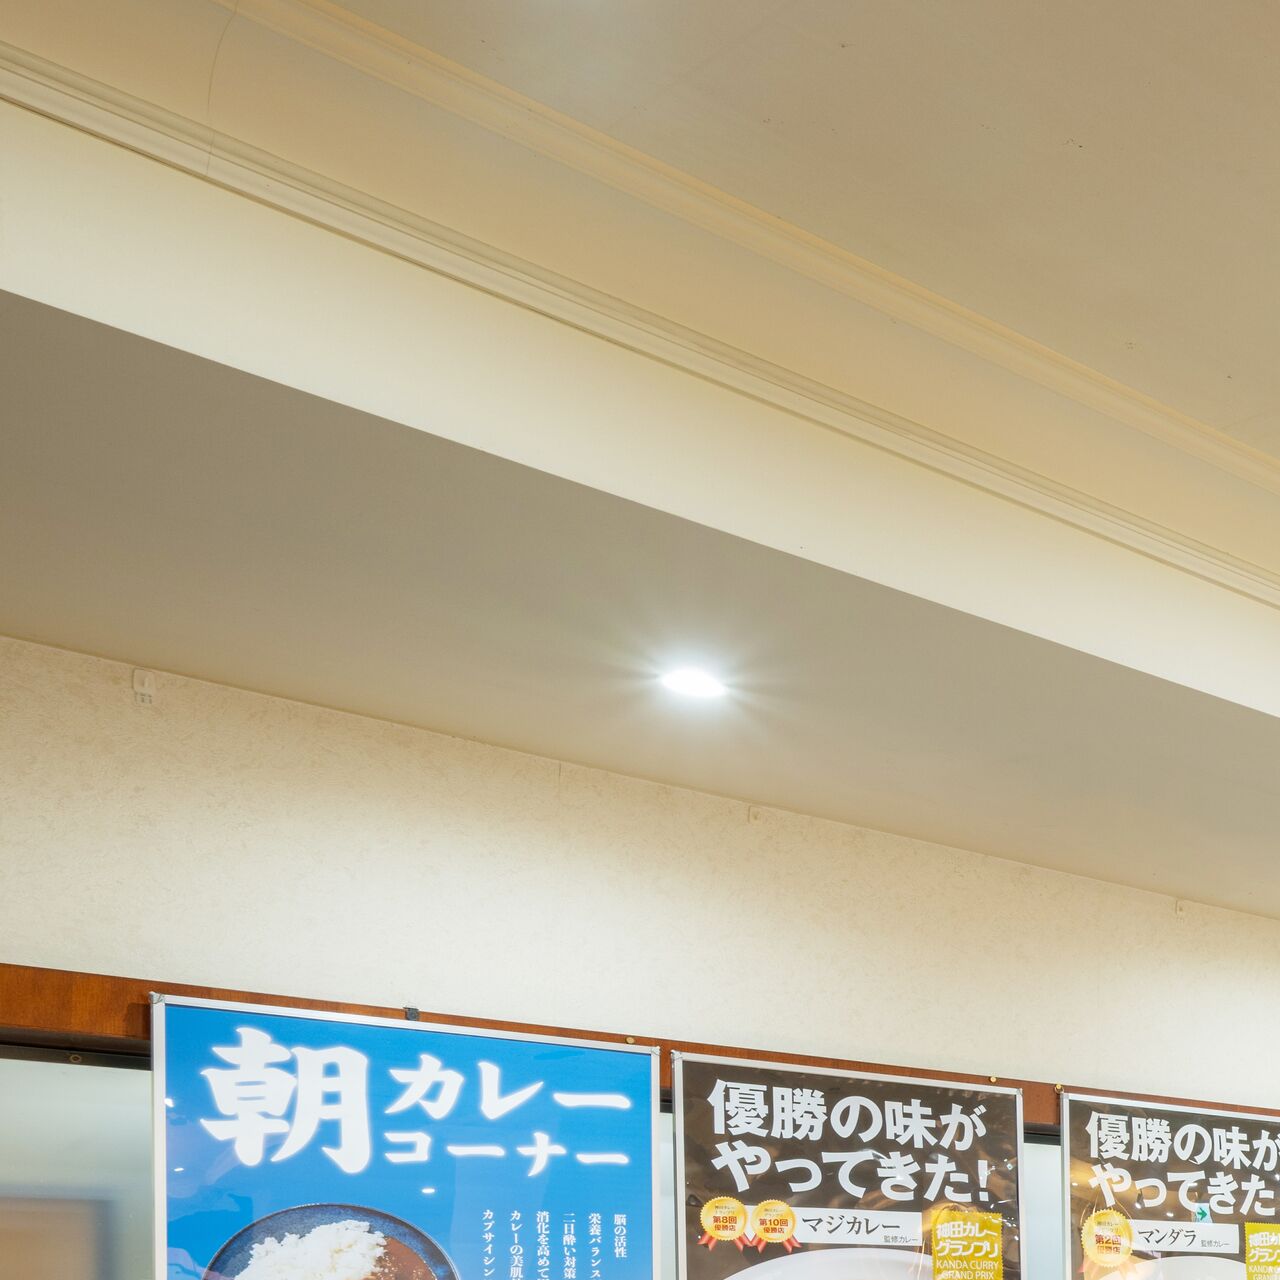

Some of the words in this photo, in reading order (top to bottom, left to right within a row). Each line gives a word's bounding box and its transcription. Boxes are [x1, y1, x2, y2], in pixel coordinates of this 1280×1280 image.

[384, 1054, 632, 1121] カレー
[200, 1026, 370, 1173] 朝
[707, 1078, 988, 1152] 優勝の味が
[383, 1131, 630, 1177] コーナー
[712, 1215, 738, 1225] 第8回
[759, 1218, 789, 1227] 第10回
[801, 1214, 901, 1236] マジカレー
[936, 1220, 998, 1239] 神田カレー
[613, 1213, 628, 1259] 脳の活性
[1137, 1228, 1198, 1247] マンダラ
[936, 1240, 999, 1258] グランプリ
[936, 1259, 969, 1270] KANDA
[970, 1260, 999, 1270] CURRY
[975, 1271, 995, 1280] PRIX
